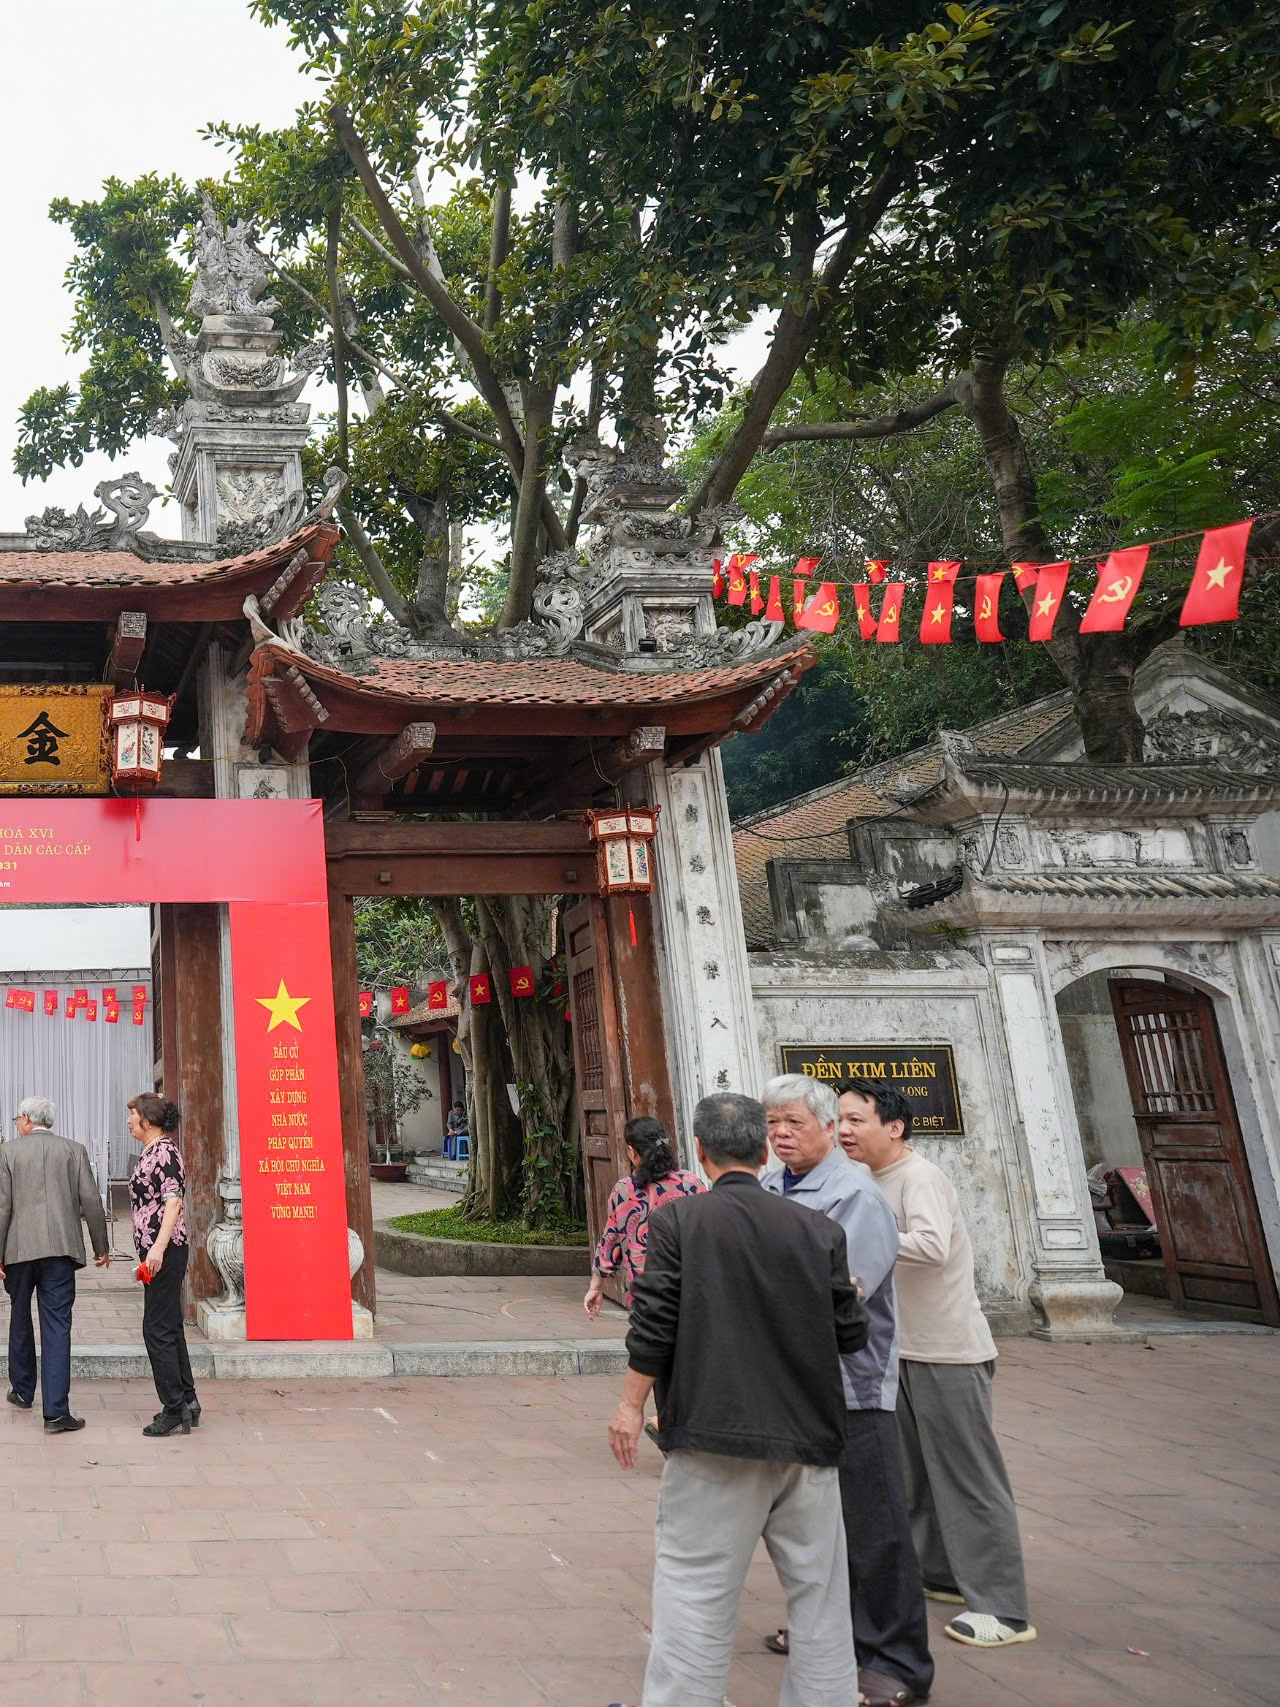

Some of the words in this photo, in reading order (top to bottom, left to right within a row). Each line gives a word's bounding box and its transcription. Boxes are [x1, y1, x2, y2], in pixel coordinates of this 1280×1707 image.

[29, 829, 54, 839] XVI
[4, 842, 32, 855] DÂN
[37, 841, 62, 855] CÁC
[66, 839, 91, 855] CẤP
[273, 1041, 287, 1058] BẦU
[290, 1041, 299, 1058] CỬ
[270, 1066, 284, 1080] GÓP
[286, 1062, 304, 1080] PHẦN
[802, 1054, 842, 1079] ĐỀN
[848, 1062, 887, 1078] KIM
[890, 1057, 936, 1078] LIÊN
[270, 1088, 285, 1103] XÂY
[287, 1091, 307, 1106] DỰNG
[272, 1112, 287, 1126] NHÀ
[288, 1110, 308, 1126] NƯỚC
[923, 1115, 945, 1128] BIỆT
[268, 1133, 287, 1149] PHÁP
[288, 1131, 313, 1149] QUYỀN
[259, 1158, 269, 1172] XÃ
[271, 1157, 284, 1175] HỘI
[286, 1154, 300, 1171] CHỦ
[302, 1156, 325, 1171] NGHĨA
[276, 1179, 292, 1198] VIỆT
[294, 1183, 311, 1195] NAM
[271, 1203, 291, 1219] VỮNG
[292, 1206, 314, 1221] MẠNH
